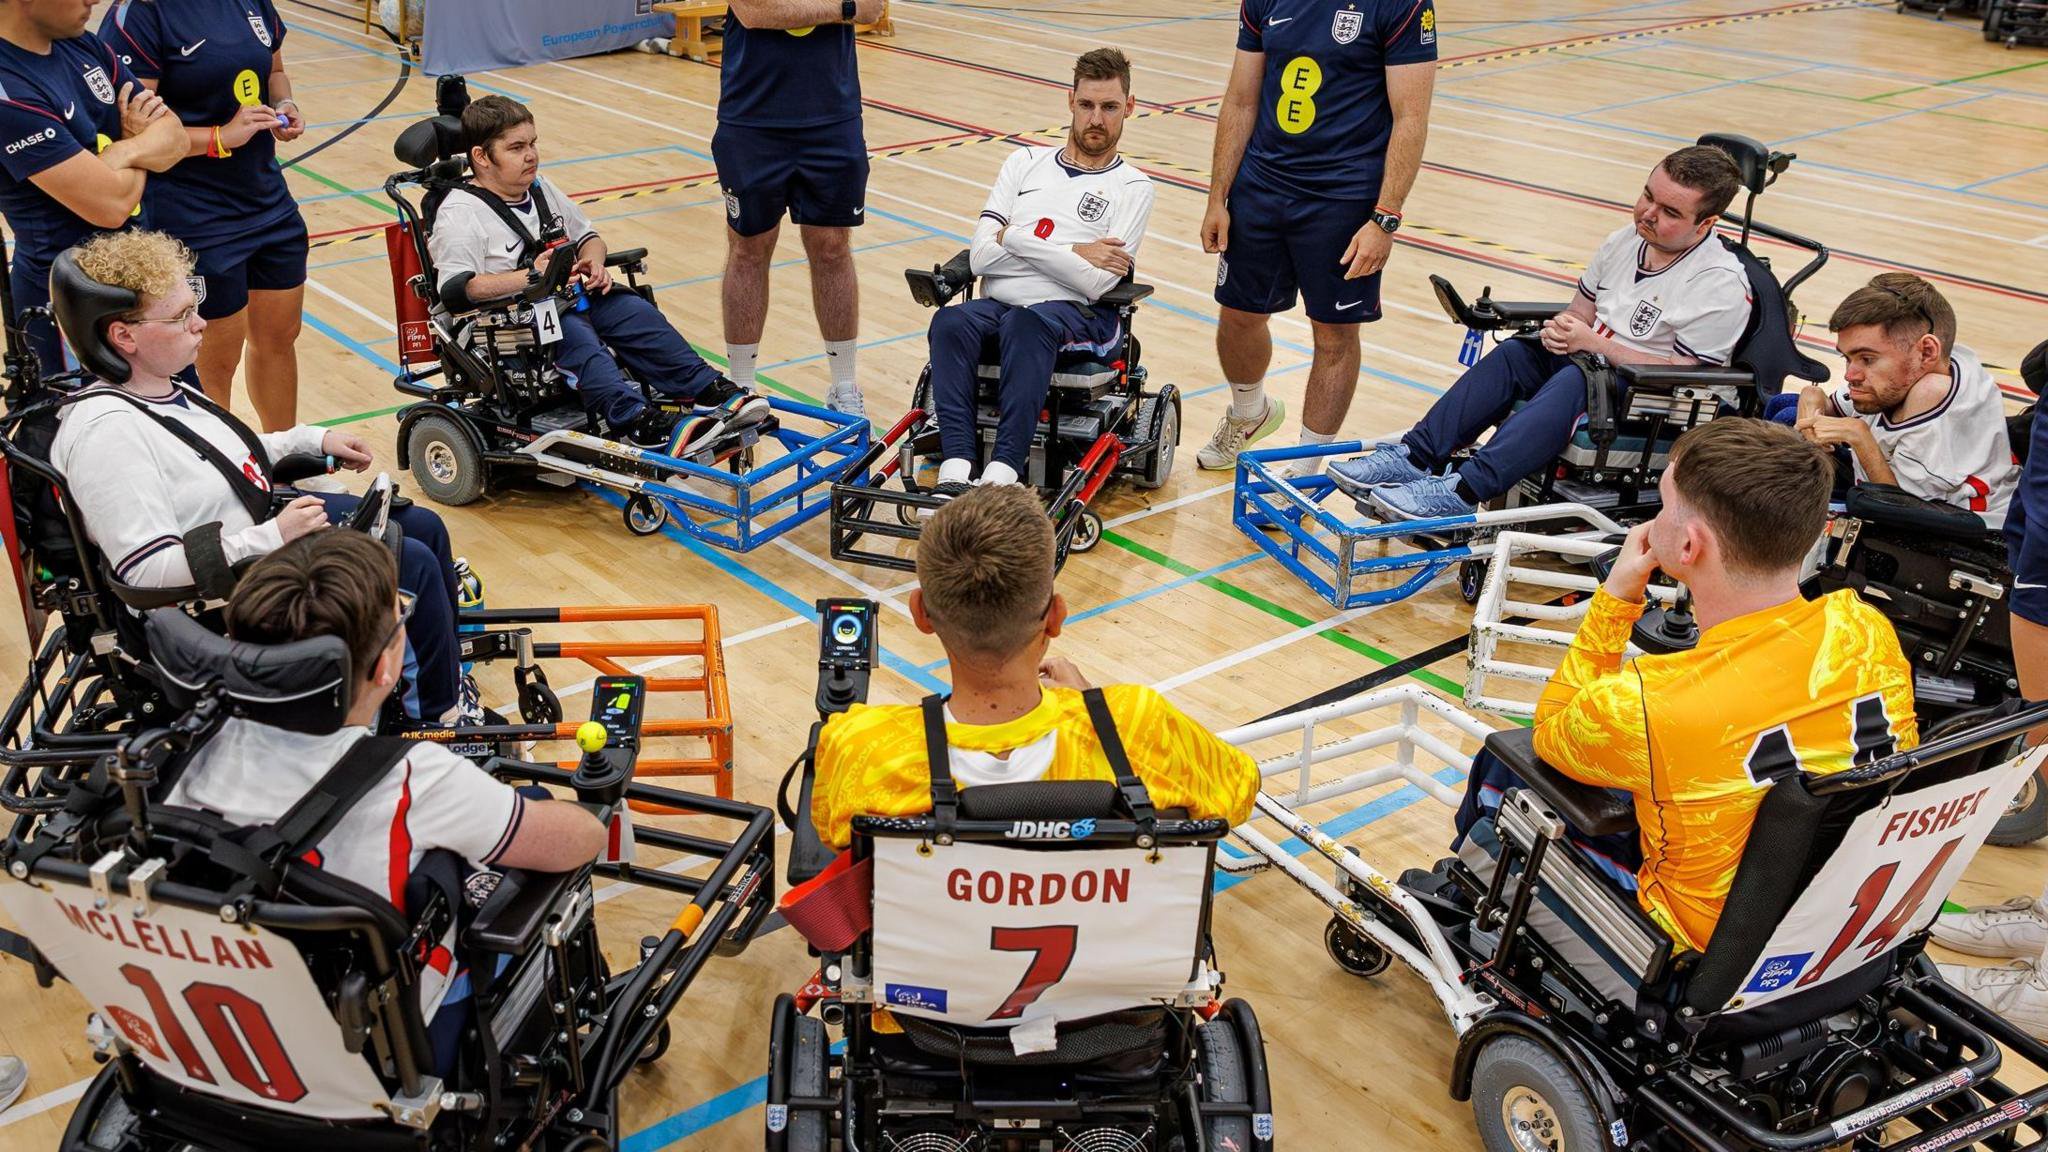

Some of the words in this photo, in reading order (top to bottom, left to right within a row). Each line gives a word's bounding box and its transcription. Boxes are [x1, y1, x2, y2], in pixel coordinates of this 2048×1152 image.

[542, 28, 601, 47] European
[242, 78, 253, 97] E
[1293, 67, 1310, 90] E
[1287, 100, 1302, 123] E
[5, 131, 46, 154] CHASE
[543, 310, 556, 335] 4
[1463, 336, 1482, 367] 11
[1004, 821, 1071, 839] JDHC
[947, 868, 1131, 906] GORDON
[1793, 833, 1967, 990] 14
[54, 898, 273, 970] MCLELLAN
[984, 925, 1079, 1021] 7
[1760, 968, 1793, 979] FIPFA
[118, 962, 310, 1104] 10
